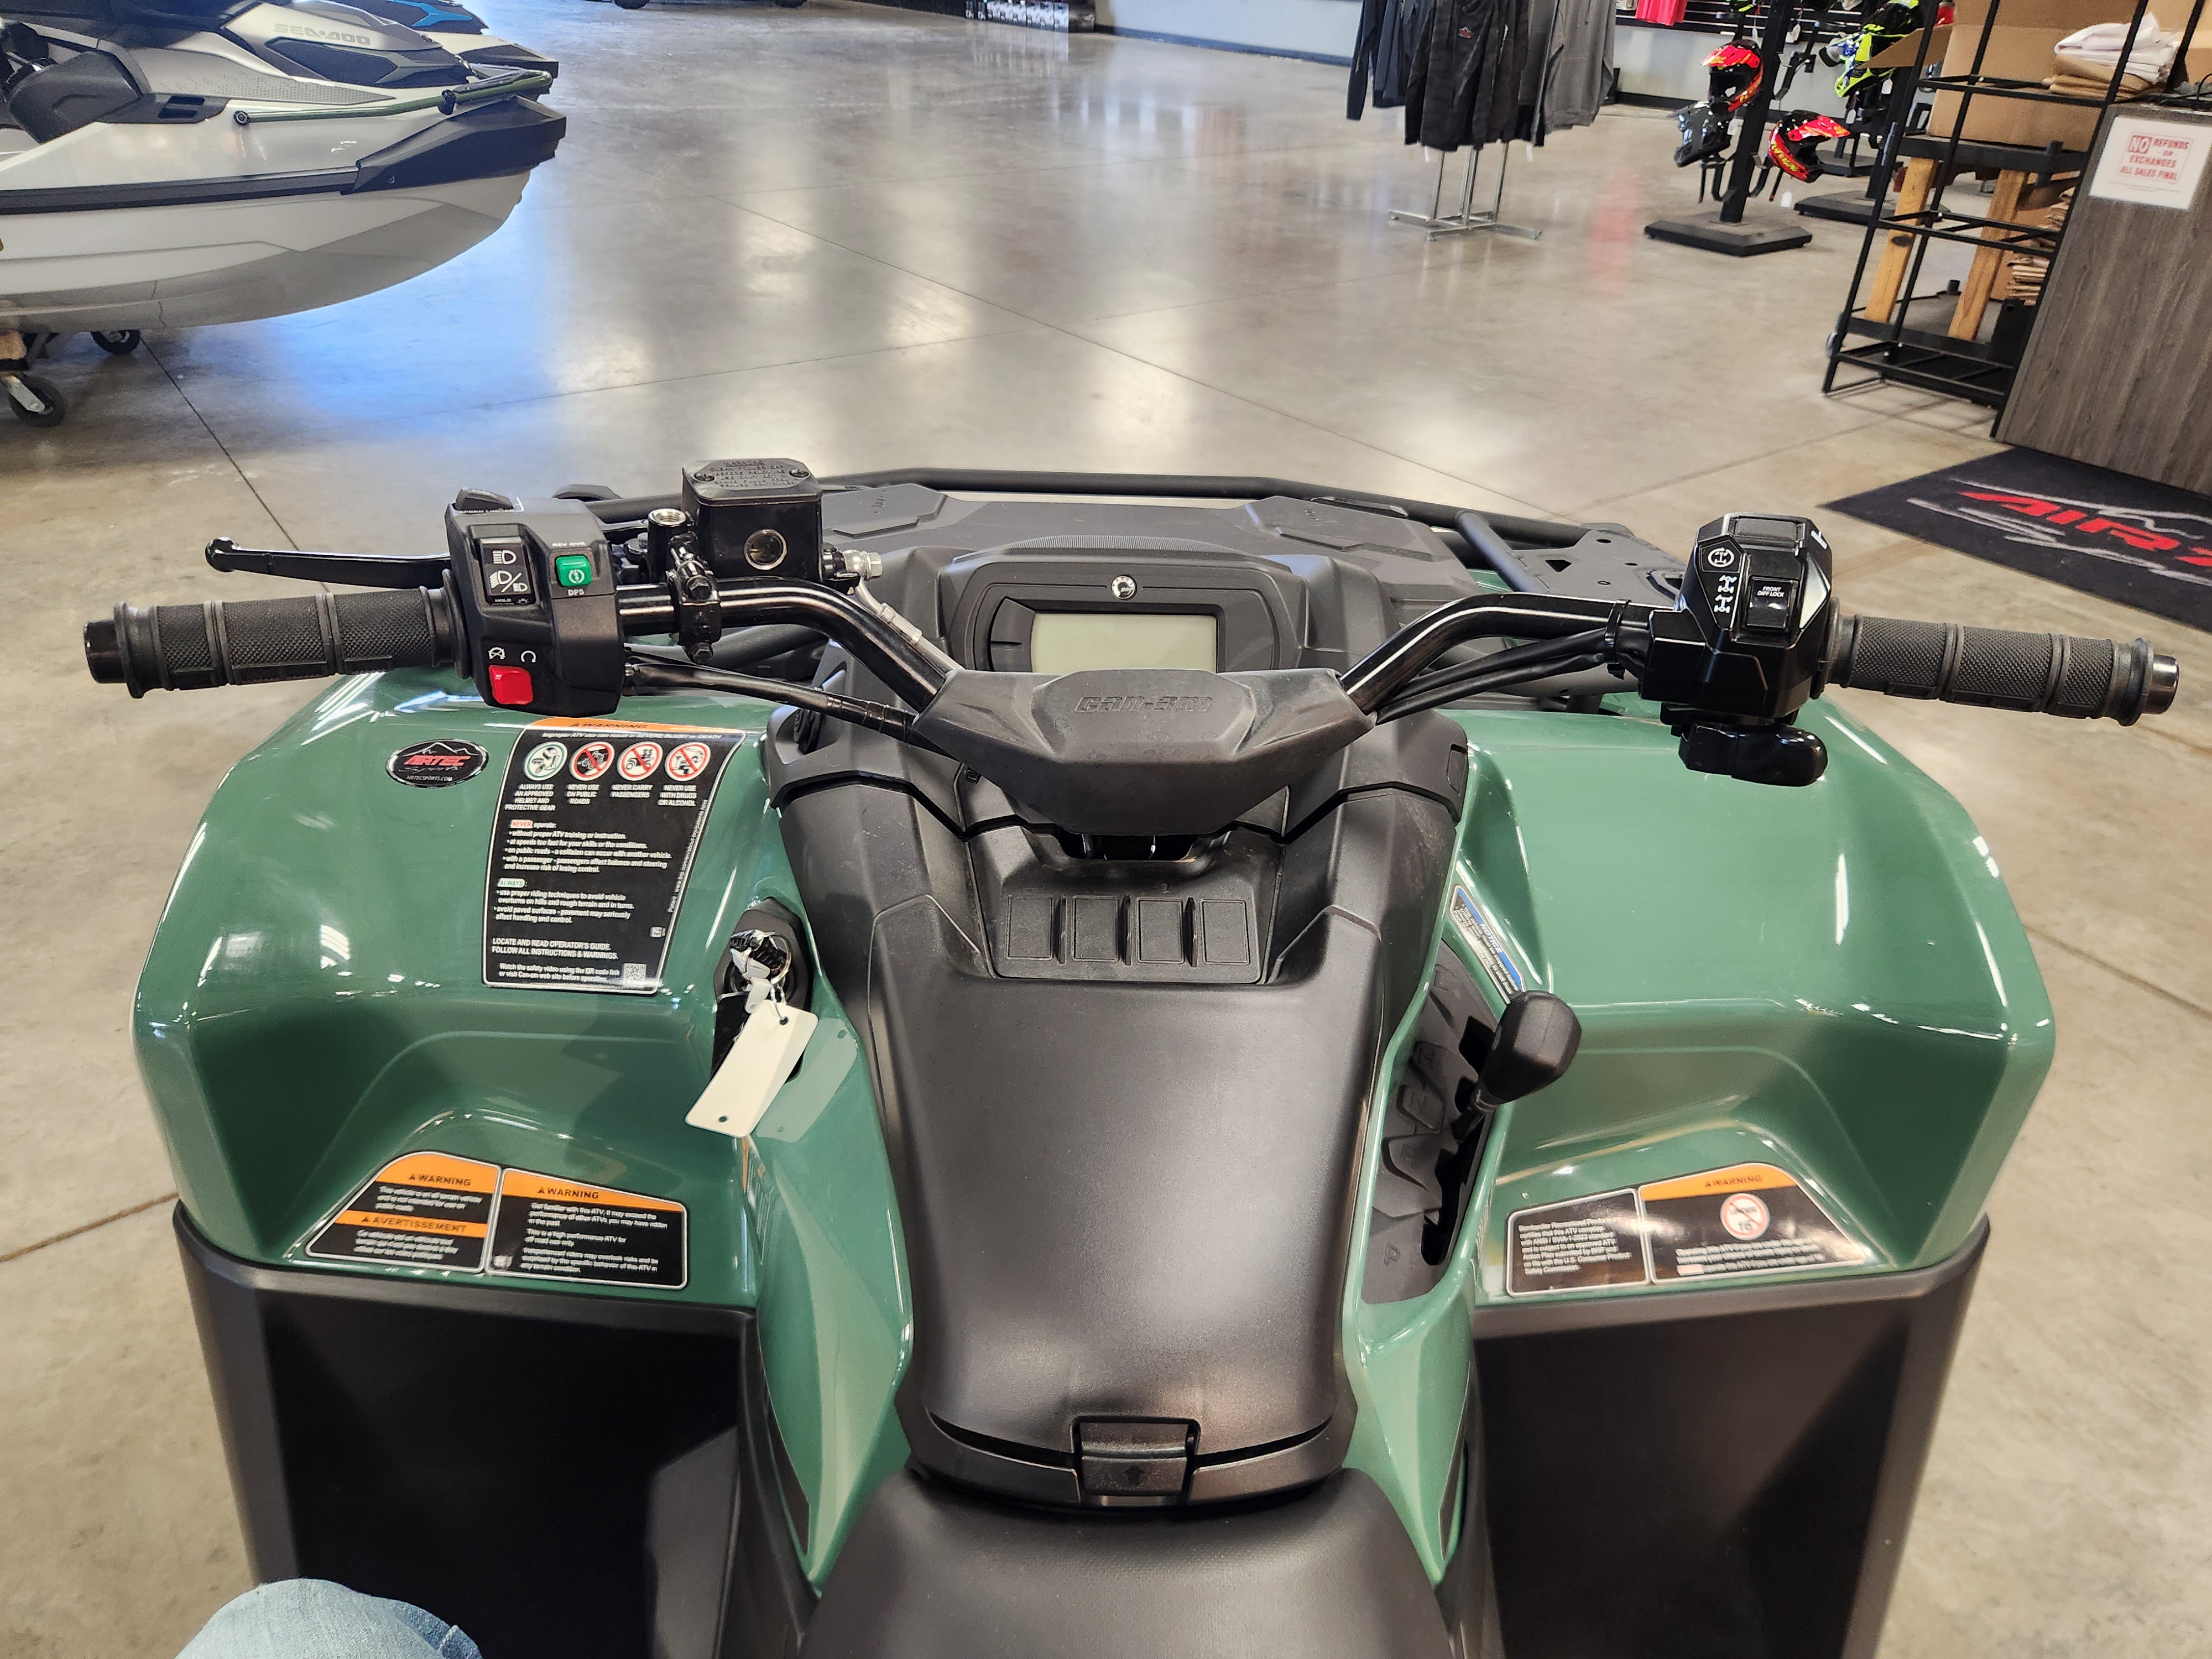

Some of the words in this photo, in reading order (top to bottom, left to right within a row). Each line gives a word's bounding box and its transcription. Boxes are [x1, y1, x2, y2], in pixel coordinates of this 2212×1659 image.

[2128, 137, 2151, 153] NO
[2153, 138, 2189, 150] REFUNDS
[2130, 155, 2177, 168] EXCHANGES
[2120, 165, 2132, 174] ALL
[2135, 168, 2156, 178] SALES
[2158, 170, 2177, 180] FINAL
[404, 755, 471, 766] AIRTEC
[565, 832, 587, 840] training
[559, 865, 577, 873] losing
[643, 860, 667, 869] steering
[513, 914, 538, 922] handling
[603, 911, 630, 920] seriously
[492, 937, 517, 946] LOCATE
[549, 941, 589, 950] OPERATOR'S
[1480, 923, 1503, 953] NOTICE
[492, 946, 518, 954] FOLLOW
[531, 948, 576, 957] INSTRUCTIONS
[583, 951, 619, 960] WARNINGS.
[526, 964, 543, 973] safety
[419, 1173, 471, 1186] WARNING
[1712, 1175, 1763, 1186] WARNING
[547, 1187, 599, 1199] WARNING
[372, 1217, 467, 1233] AVERTISSEMENT
[1738, 1220, 1753, 1232] 16
